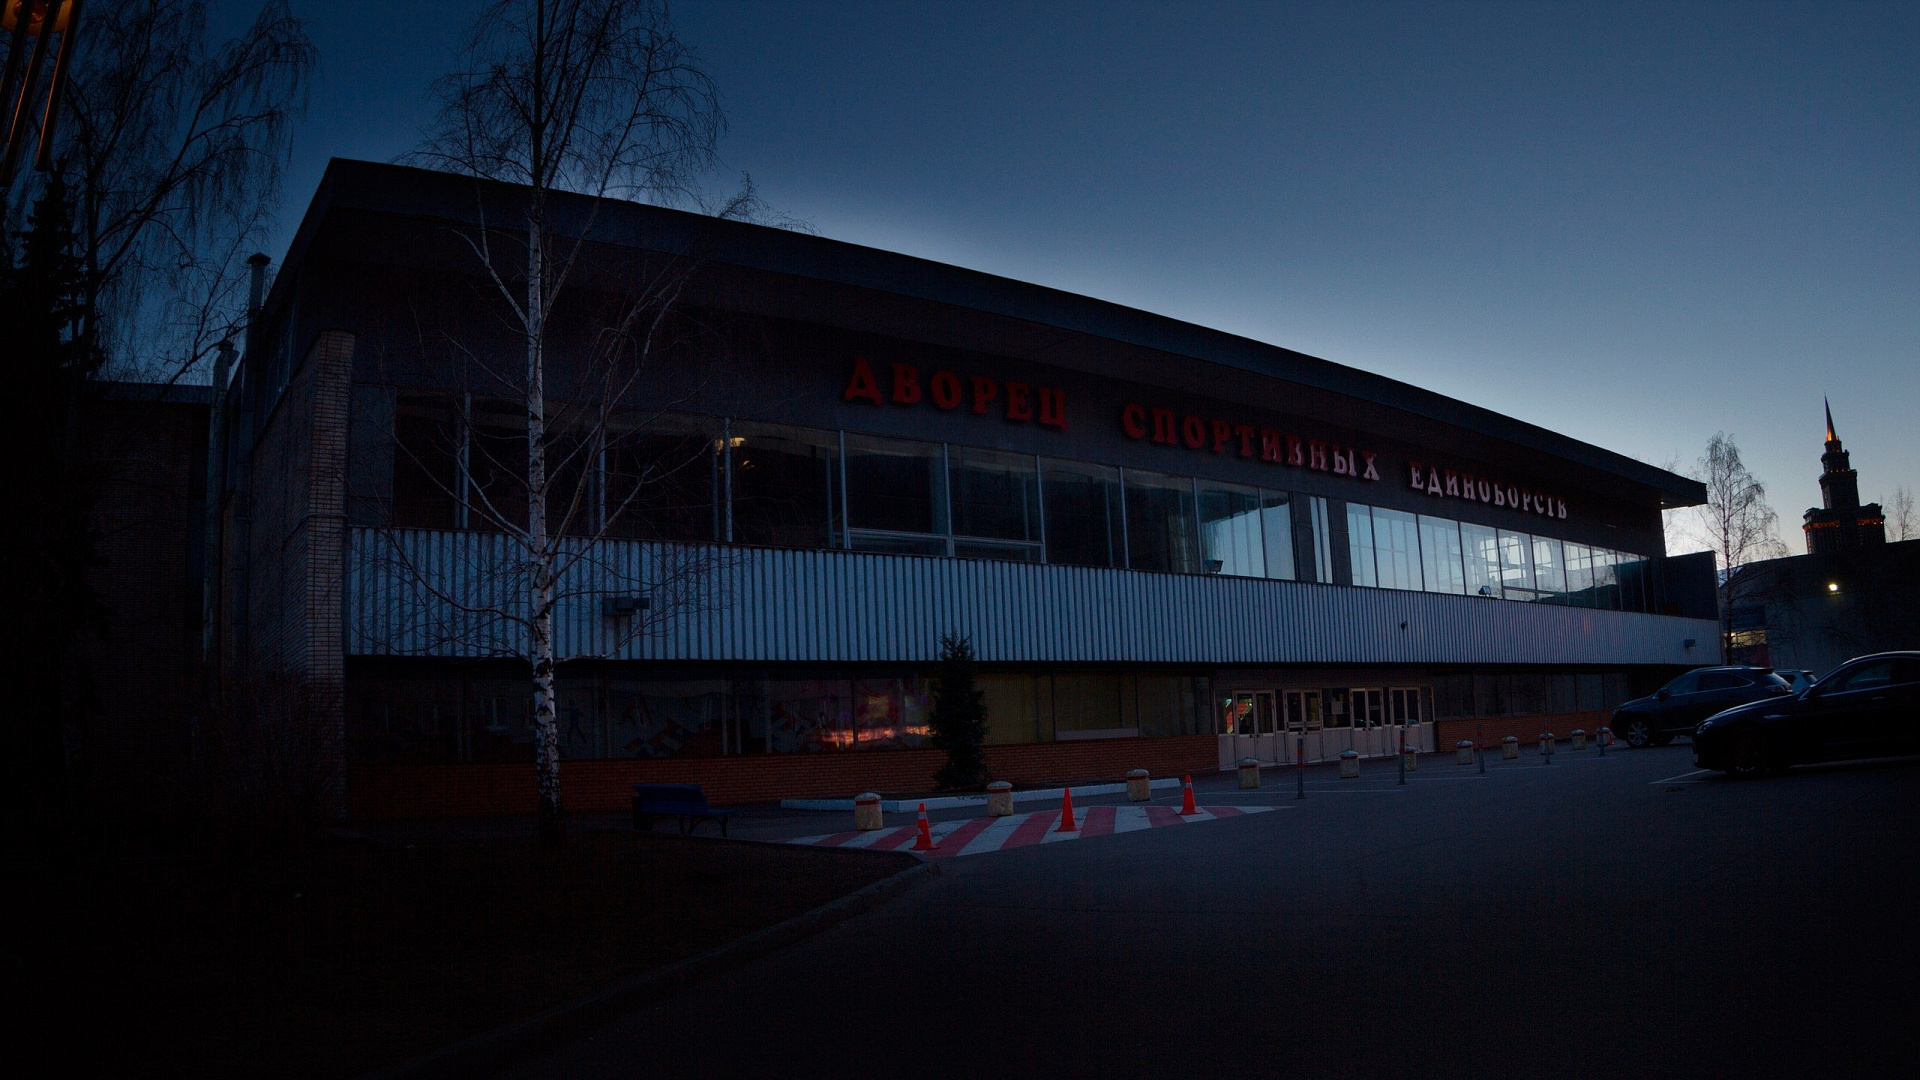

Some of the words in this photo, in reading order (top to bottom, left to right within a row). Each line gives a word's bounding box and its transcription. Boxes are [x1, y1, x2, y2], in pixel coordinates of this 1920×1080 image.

[844, 356, 1068, 432] ДВОРЕЦ
[1122, 402, 1380, 481] СПОРТИВНЫХ
[1409, 461, 1567, 519] ЕДИНОБОРСТВ
